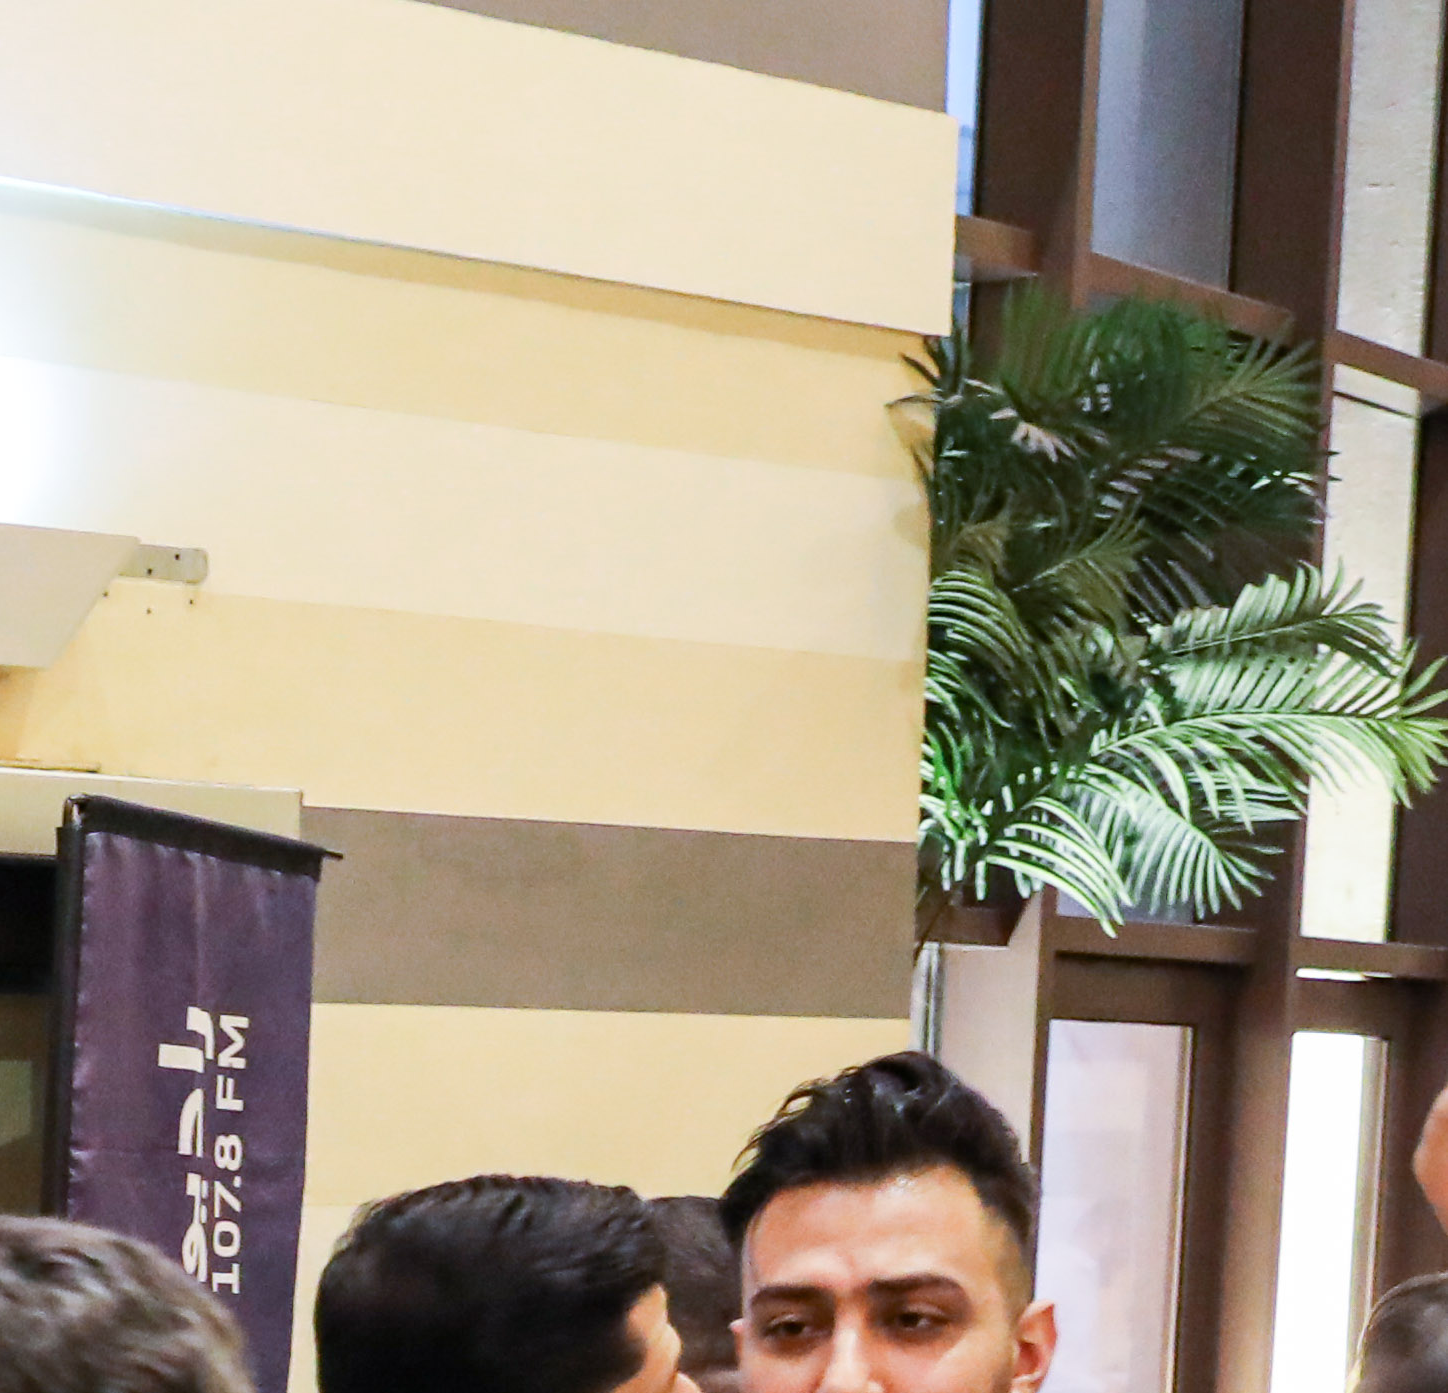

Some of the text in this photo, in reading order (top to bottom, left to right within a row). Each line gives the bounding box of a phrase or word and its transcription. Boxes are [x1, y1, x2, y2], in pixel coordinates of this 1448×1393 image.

[157, 1005, 215, 1284] راديو
[210, 1013, 250, 1296] 107.8 FM
